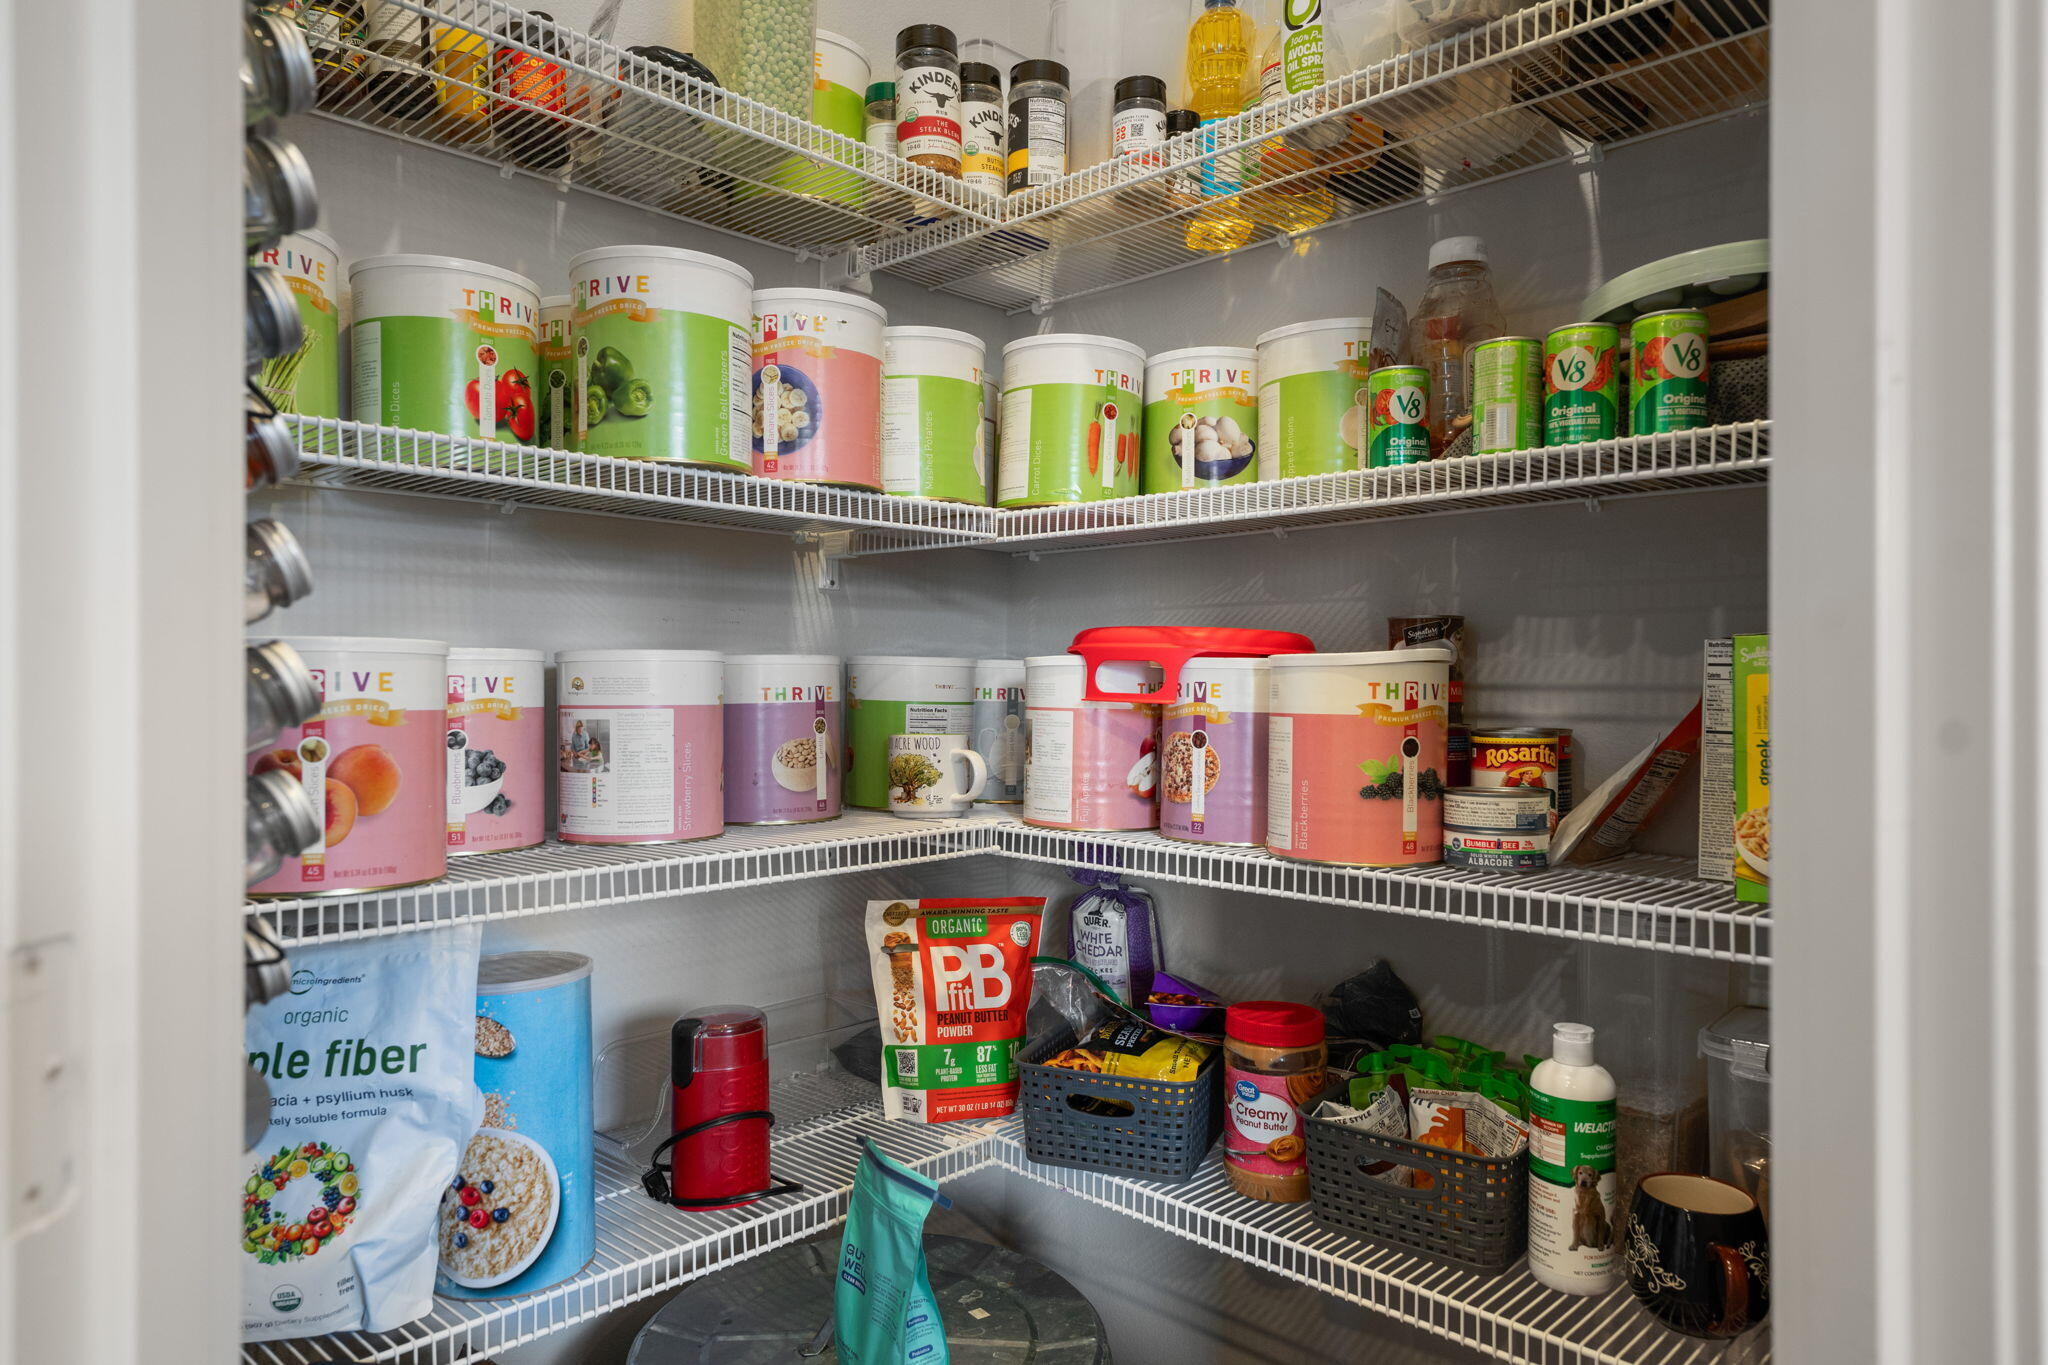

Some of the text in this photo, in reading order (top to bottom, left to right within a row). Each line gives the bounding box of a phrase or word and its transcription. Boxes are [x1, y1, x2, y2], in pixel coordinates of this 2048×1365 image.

[1287, 41, 1323, 62] AVOCAD
[1287, 54, 1323, 74] OIL SPR
[931, 119, 949, 128] THE
[968, 110, 1004, 129] KINDE
[918, 126, 942, 134] STEAK
[981, 163, 1002, 173] STEAK
[249, 248, 326, 282] RIVE
[571, 275, 650, 305] THRIVE
[462, 288, 538, 328] THRIVE
[1672, 338, 1701, 371] V8
[1171, 369, 1250, 386] THRIVE
[1557, 353, 1586, 383] V8
[1094, 369, 1142, 395] THRIV
[720, 351, 729, 457] Green Bell Peppers
[1396, 390, 1421, 419] V8
[1551, 403, 1596, 418] Original
[767, 410, 775, 445] Banana
[925, 411, 933, 490] Mashed Potatoes
[1389, 437, 1427, 447] Original
[1407, 627, 1438, 640] Signature
[448, 677, 514, 693] RIVE
[761, 686, 833, 701] THRIVE
[1368, 681, 1446, 700] THRIVE
[894, 736, 941, 751] ACRE WOOD
[1485, 744, 1557, 768] Rosarita
[683, 742, 693, 831] Strawberry Slices
[1299, 779, 1309, 850] Blackberries
[1466, 840, 1517, 849] BUMBLE BEE
[1468, 857, 1514, 867] ALBACORE
[920, 907, 986, 916] AWARD-WINNING
[932, 917, 983, 935] ORGANIC
[283, 1007, 349, 1028] organic
[937, 1010, 1009, 1025] PEANUT BUTTER
[937, 1025, 974, 1038] POWDER
[247, 1038, 427, 1080] ple fiber
[975, 1064, 997, 1074] LESS FAT
[270, 1093, 298, 1107] acia
[315, 1089, 376, 1107] psyllium
[379, 1087, 414, 1099] husk
[294, 1113, 338, 1125] soluble
[341, 1106, 388, 1119] formula
[936, 1106, 948, 1114] NET
[958, 1104, 966, 1112] 30
[981, 1102, 989, 1110] LB
[1236, 1102, 1288, 1124] Creamy
[1349, 1110, 1372, 1123] STYLE
[1236, 1115, 1289, 1132] Peanut Butter
[276, 1291, 296, 1300] USDA
